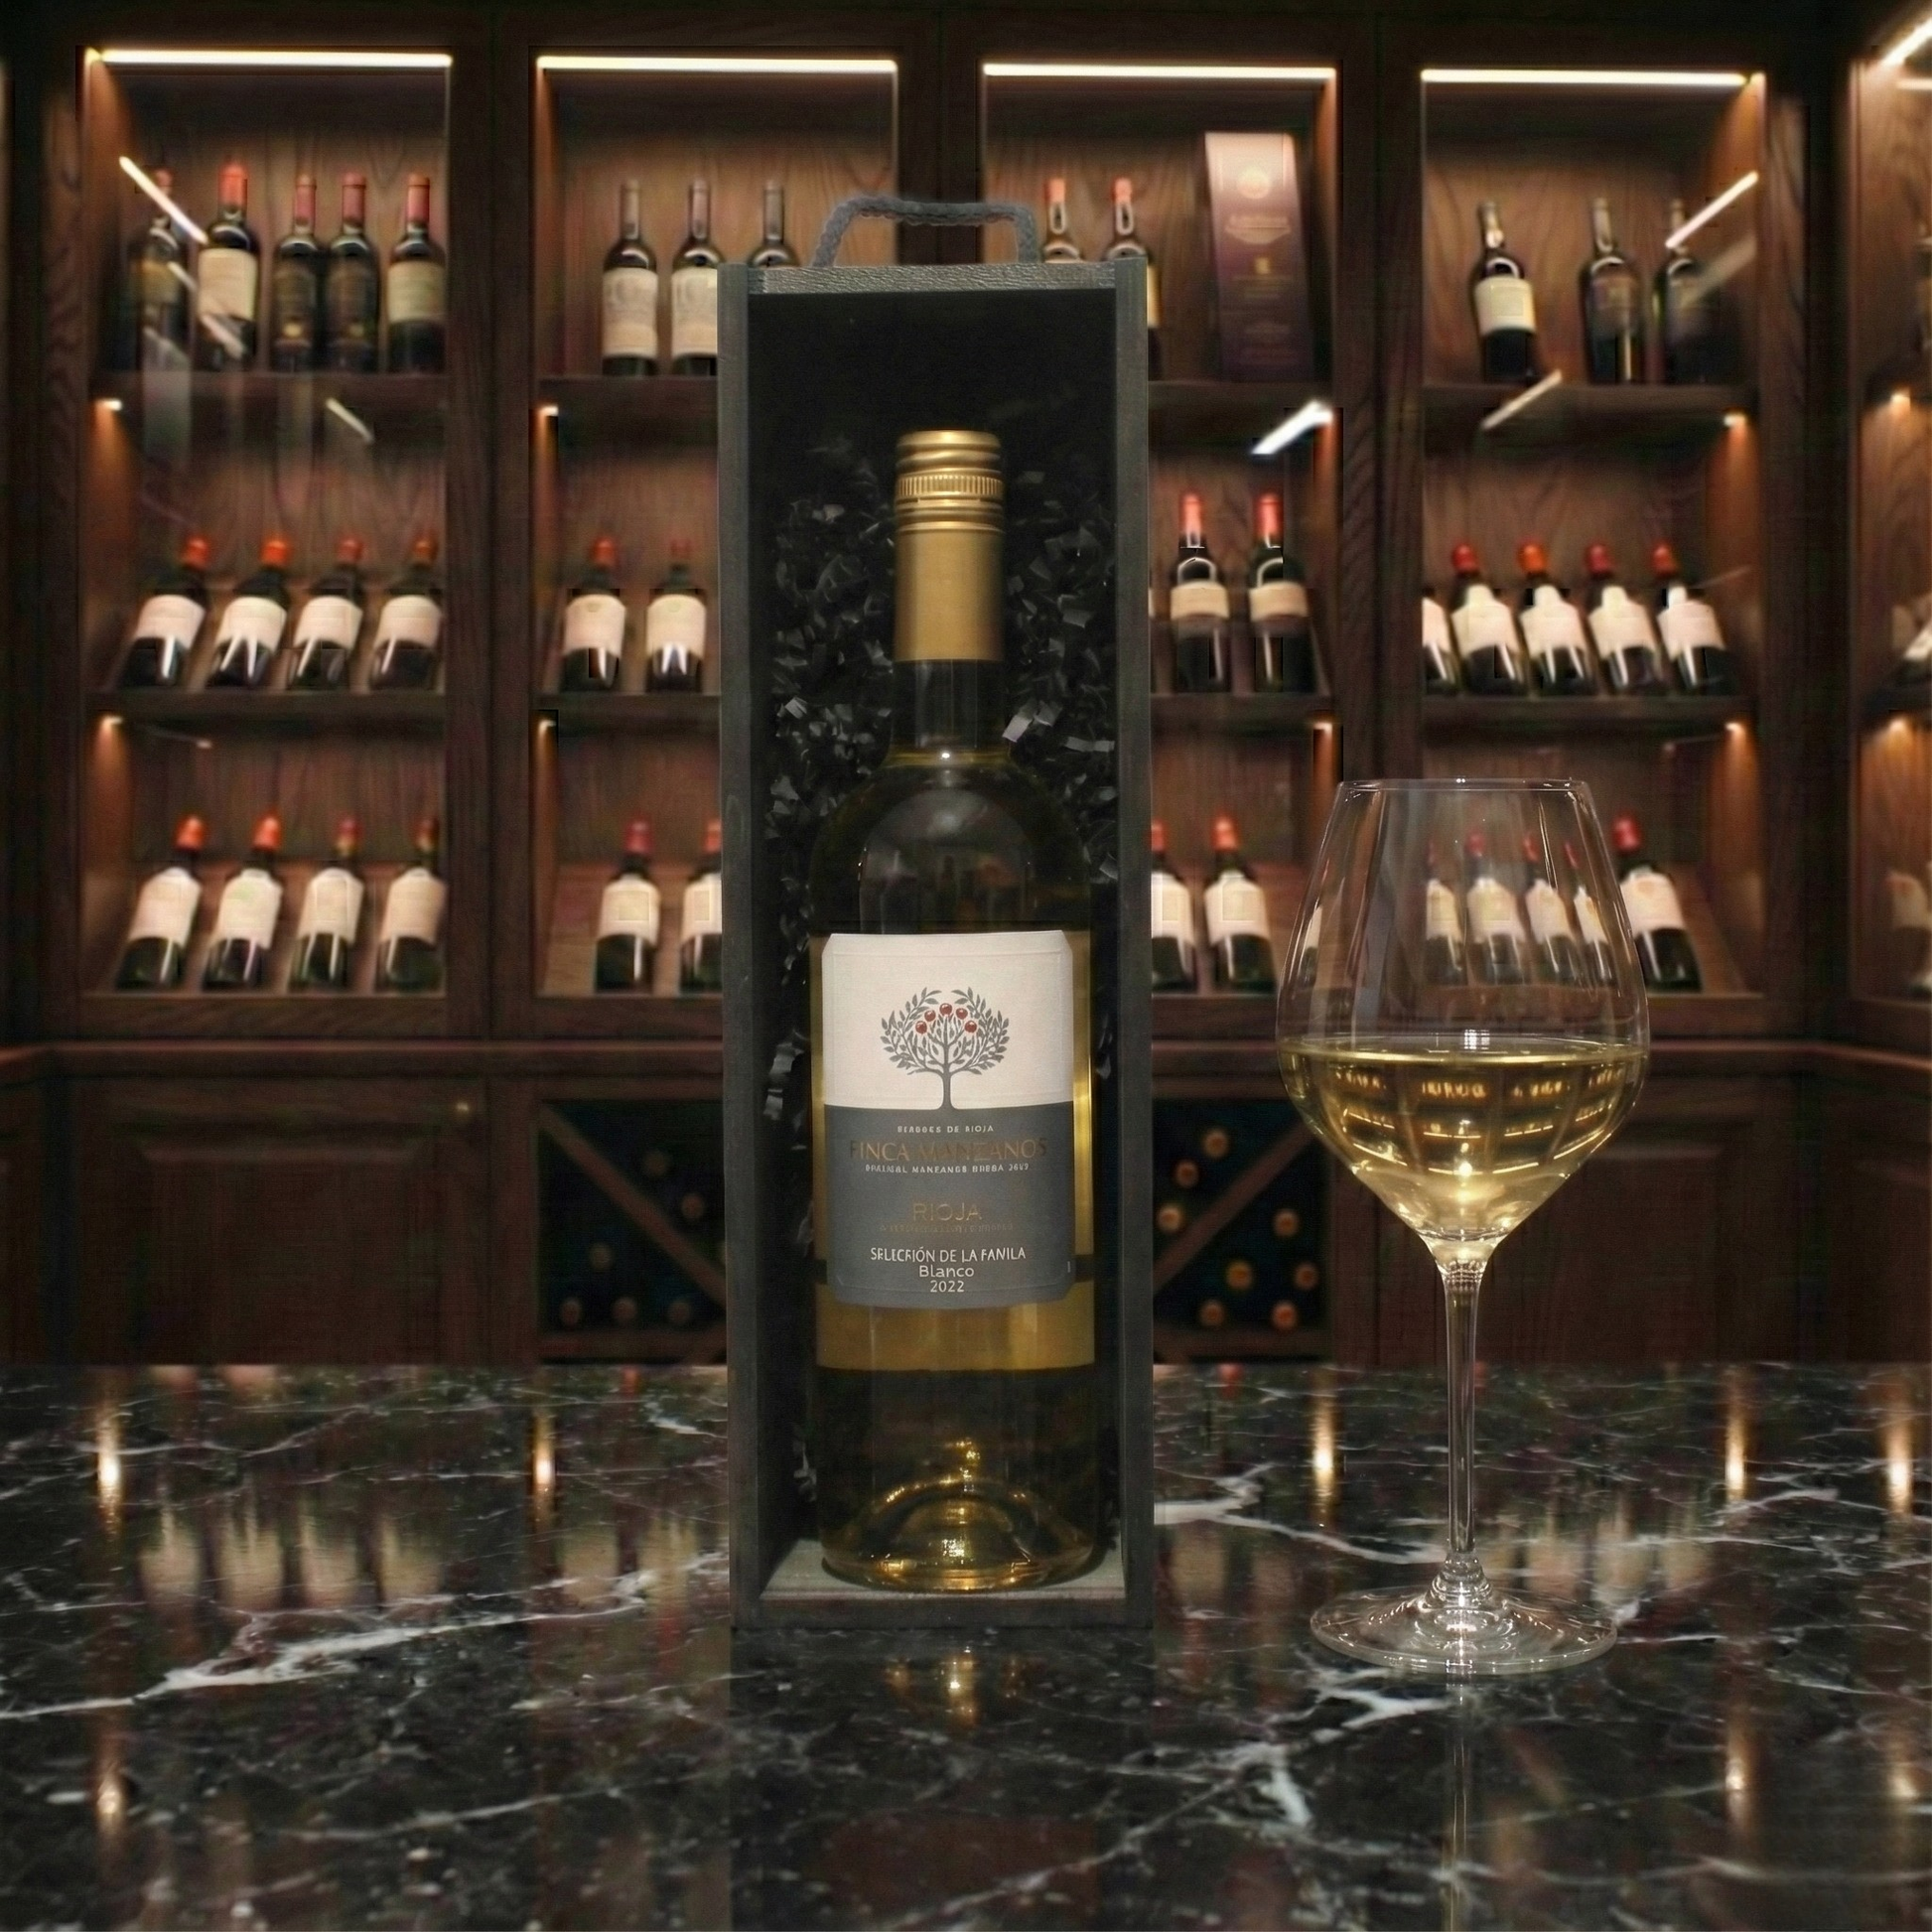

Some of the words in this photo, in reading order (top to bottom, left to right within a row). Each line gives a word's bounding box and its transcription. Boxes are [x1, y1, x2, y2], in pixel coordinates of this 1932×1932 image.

[946, 1125, 959, 1134] DE
[850, 1139, 910, 1162] FINCA
[912, 1202, 983, 1221] RIOJA
[939, 1249, 957, 1263] DE
[961, 1248, 978, 1263] LA
[918, 1265, 975, 1278] Blanco
[929, 1280, 965, 1293] 2022
